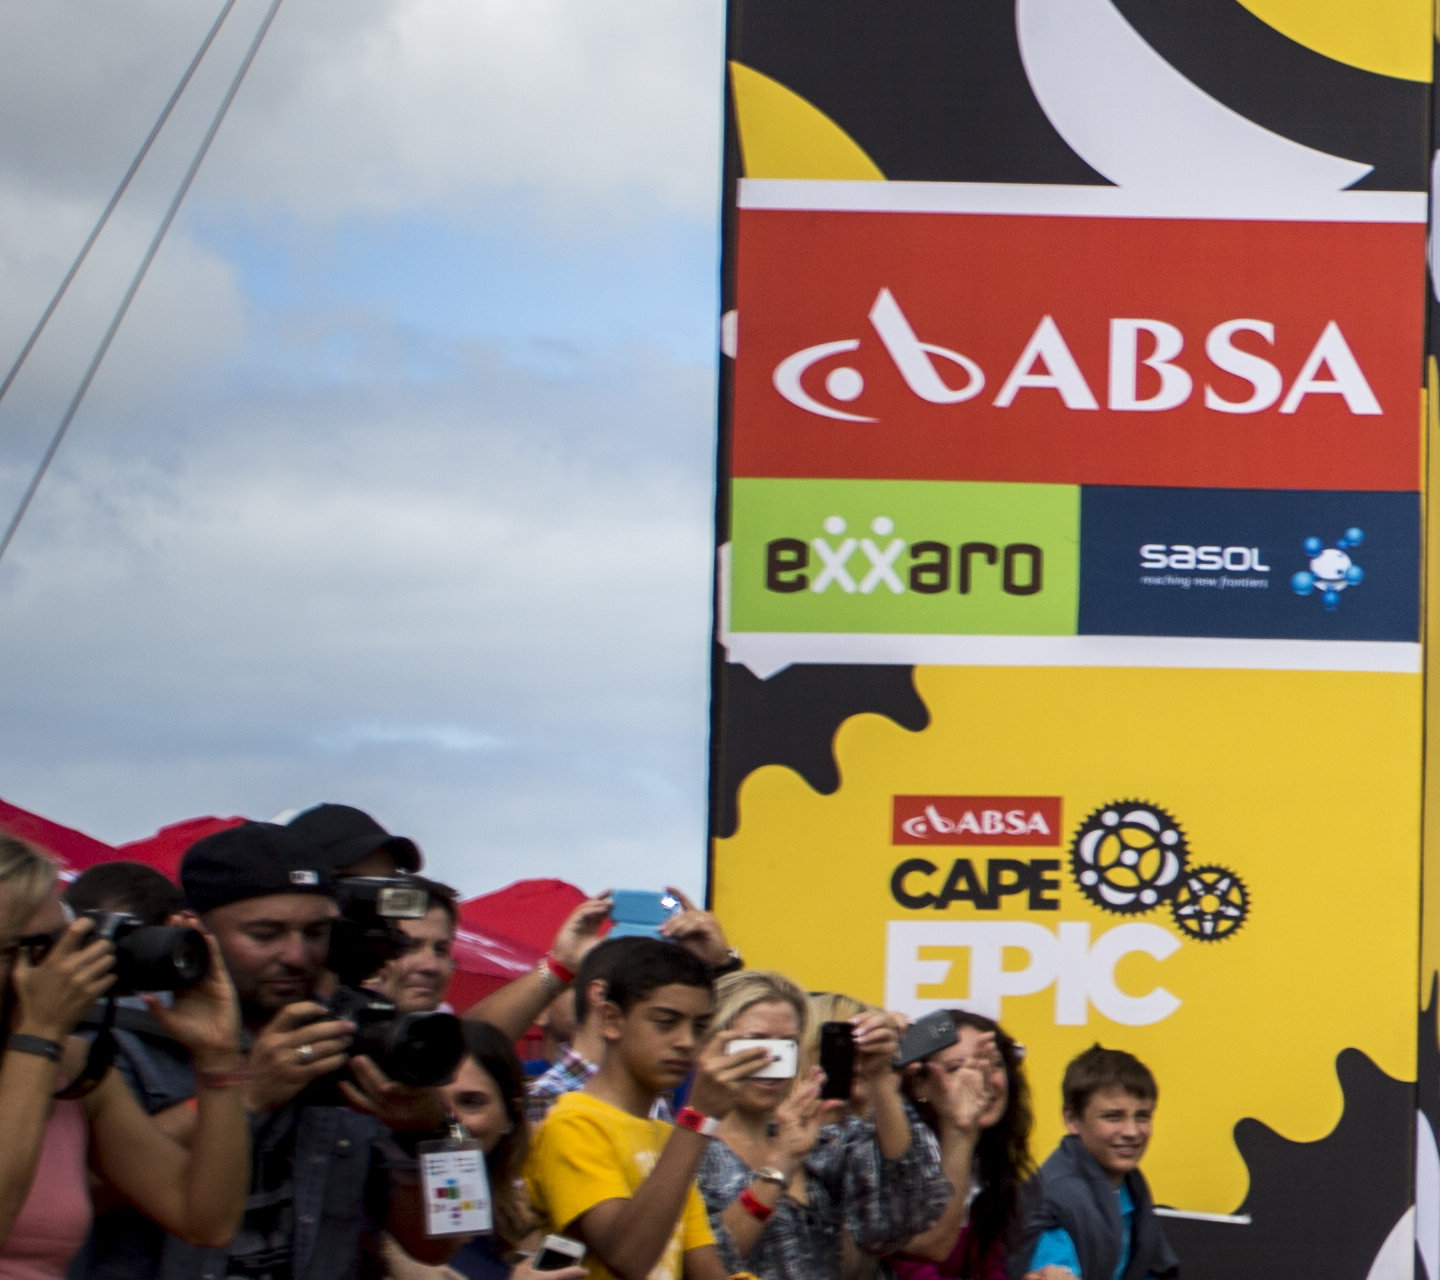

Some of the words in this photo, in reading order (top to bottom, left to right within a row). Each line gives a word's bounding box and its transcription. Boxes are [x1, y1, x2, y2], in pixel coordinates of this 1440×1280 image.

[992, 314, 1384, 416] ABSA
[763, 516, 1044, 596] exxaro
[956, 808, 1051, 835] ABSA
[890, 857, 1061, 910] CAPE
[882, 919, 1184, 1026] EPIC
